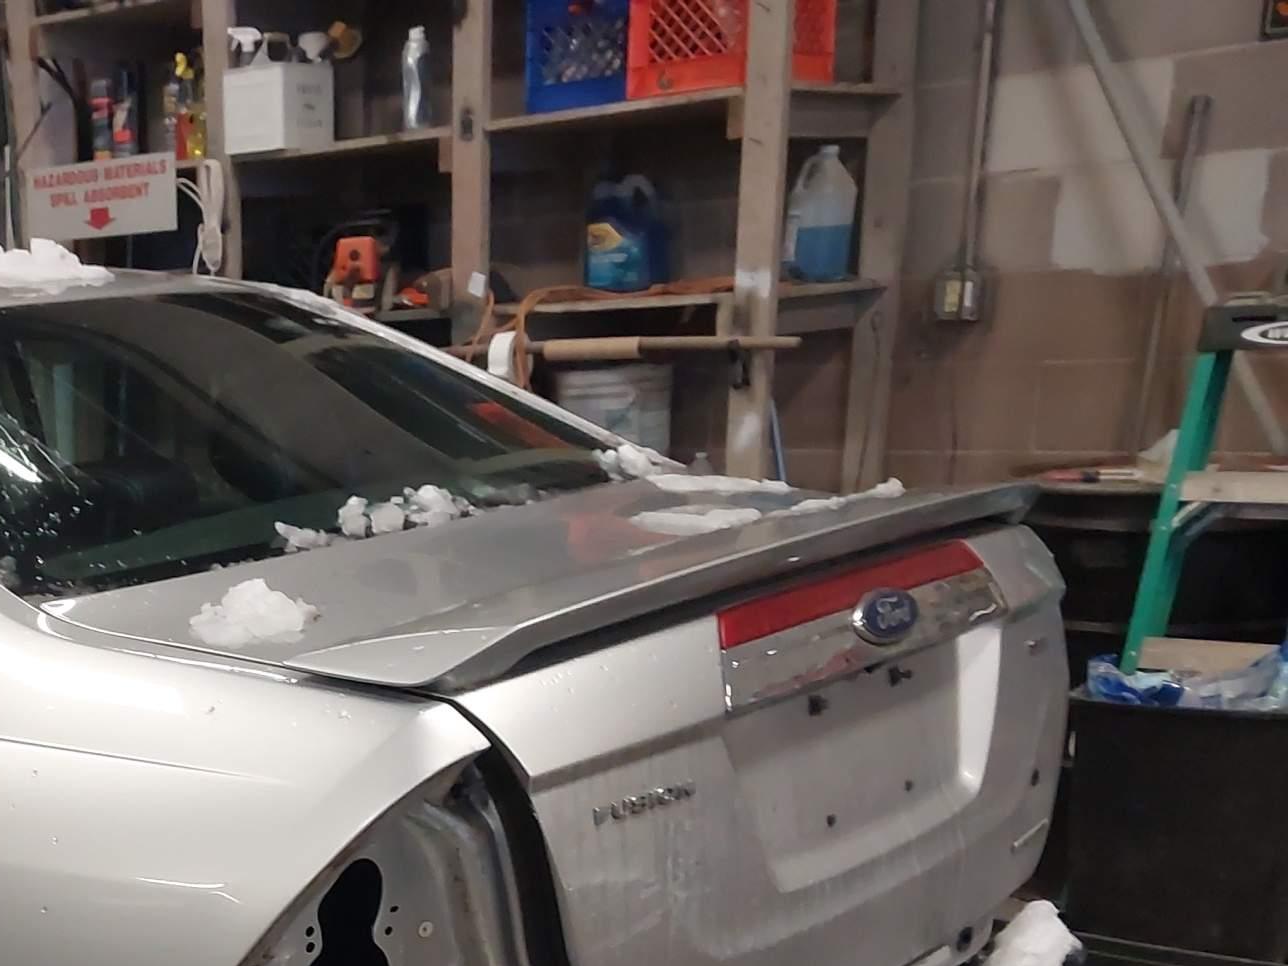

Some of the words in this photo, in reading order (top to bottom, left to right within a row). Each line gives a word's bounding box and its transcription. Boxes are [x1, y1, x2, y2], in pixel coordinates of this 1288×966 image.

[33, 168, 99, 190] HAZARDOUS
[103, 159, 168, 181] MATERIALS
[50, 192, 78, 208] SPILL
[84, 181, 150, 203] ABSORBENT
[592, 779, 697, 827] FUSION
